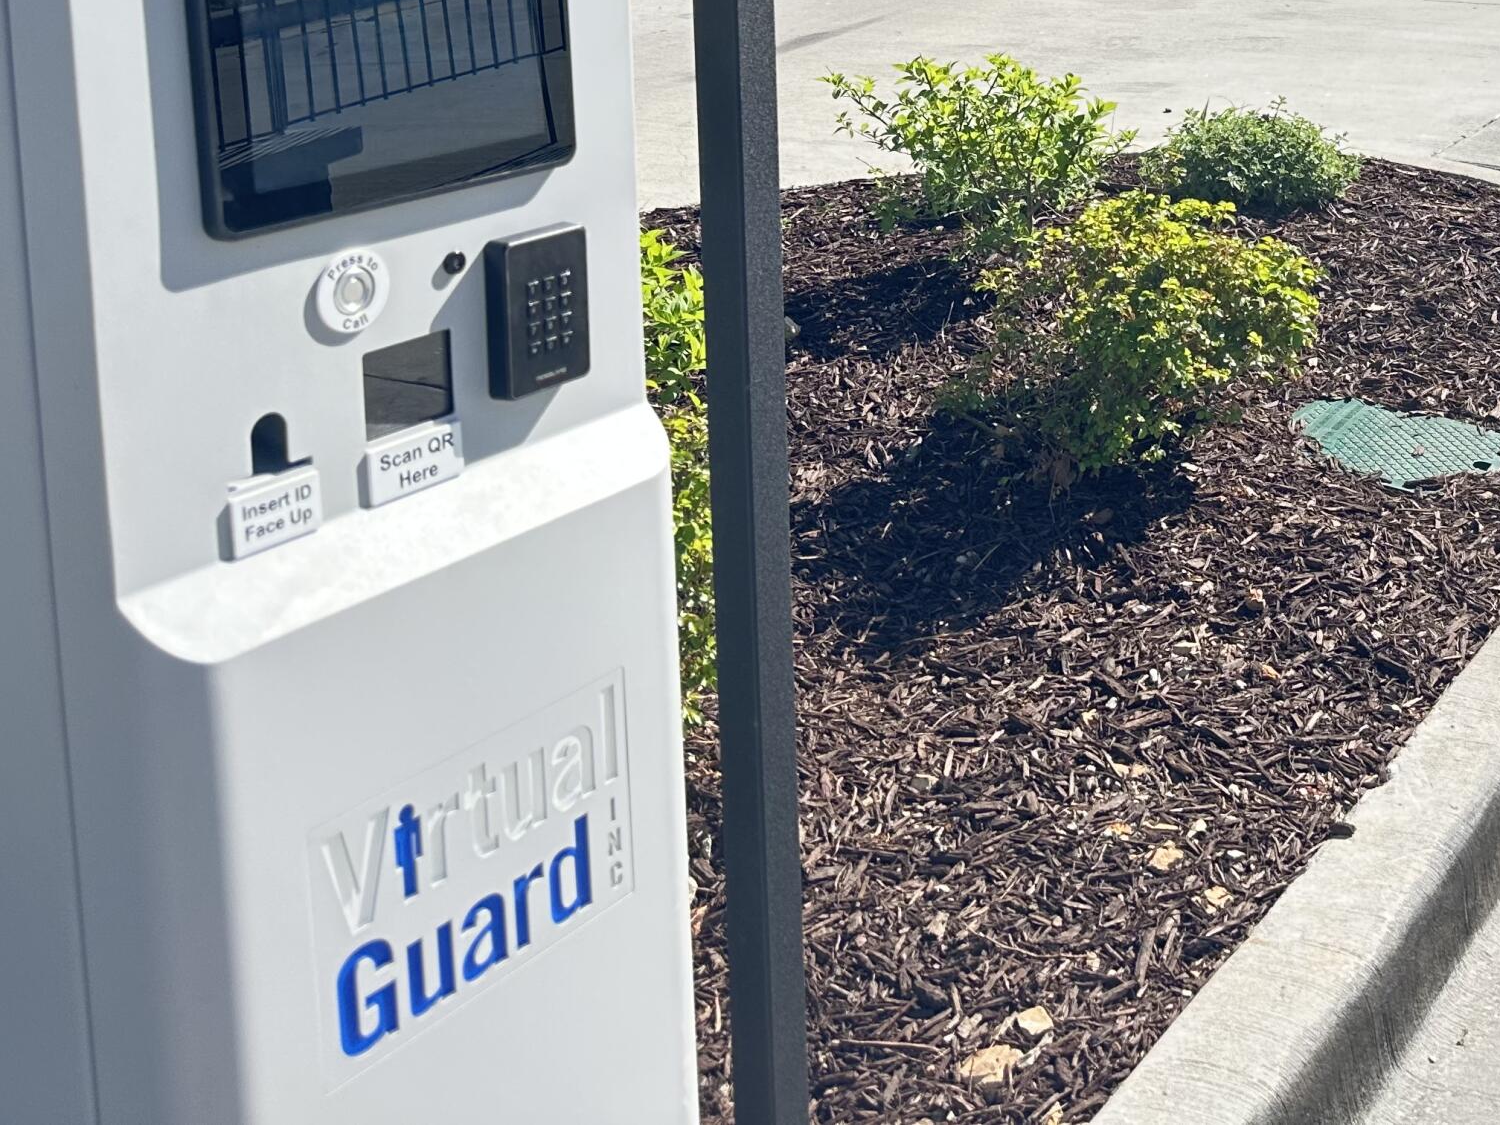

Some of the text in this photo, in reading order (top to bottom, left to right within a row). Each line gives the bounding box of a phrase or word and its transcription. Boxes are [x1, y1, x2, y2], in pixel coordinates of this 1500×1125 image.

[327, 255, 379, 281] Press to
[342, 313, 369, 330] Call
[379, 431, 455, 472] Scan QR
[399, 463, 439, 489] Here
[241, 483, 312, 522] Insert ID
[243, 506, 313, 543] Face Up
[320, 683, 619, 936] Virtual
[336, 812, 594, 1058] Guard
